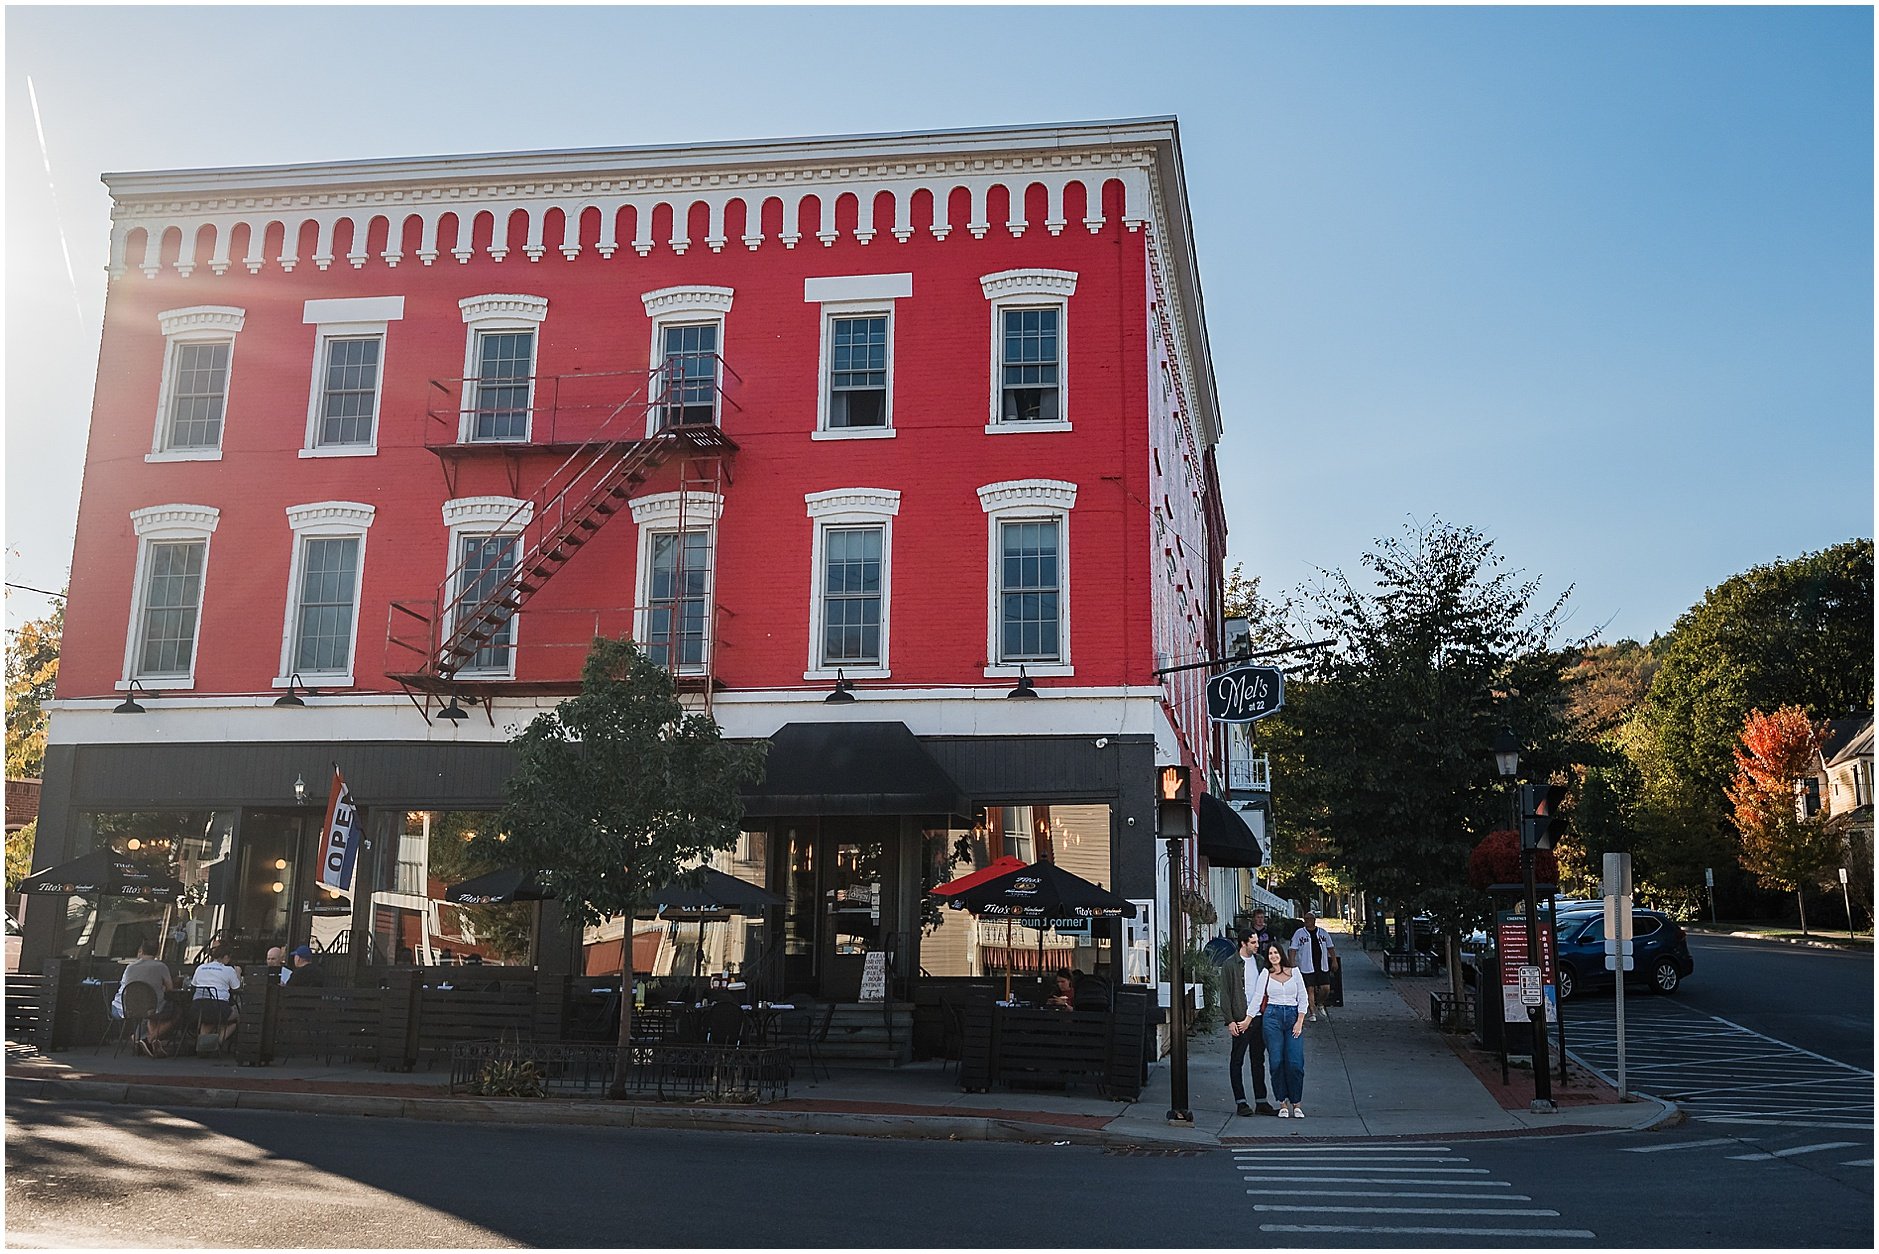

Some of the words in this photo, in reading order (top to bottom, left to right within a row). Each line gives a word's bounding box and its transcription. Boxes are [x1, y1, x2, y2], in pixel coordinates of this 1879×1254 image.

[1218, 675, 1268, 717] Mel's
[1248, 702, 1256, 711] at
[1256, 701, 1265, 710] 22
[38, 882, 63, 892] Tito's
[121, 885, 141, 894] Tito's
[983, 903, 1010, 914] Tito's
[1074, 906, 1093, 916] Tito's
[1049, 917, 1084, 927] corner
